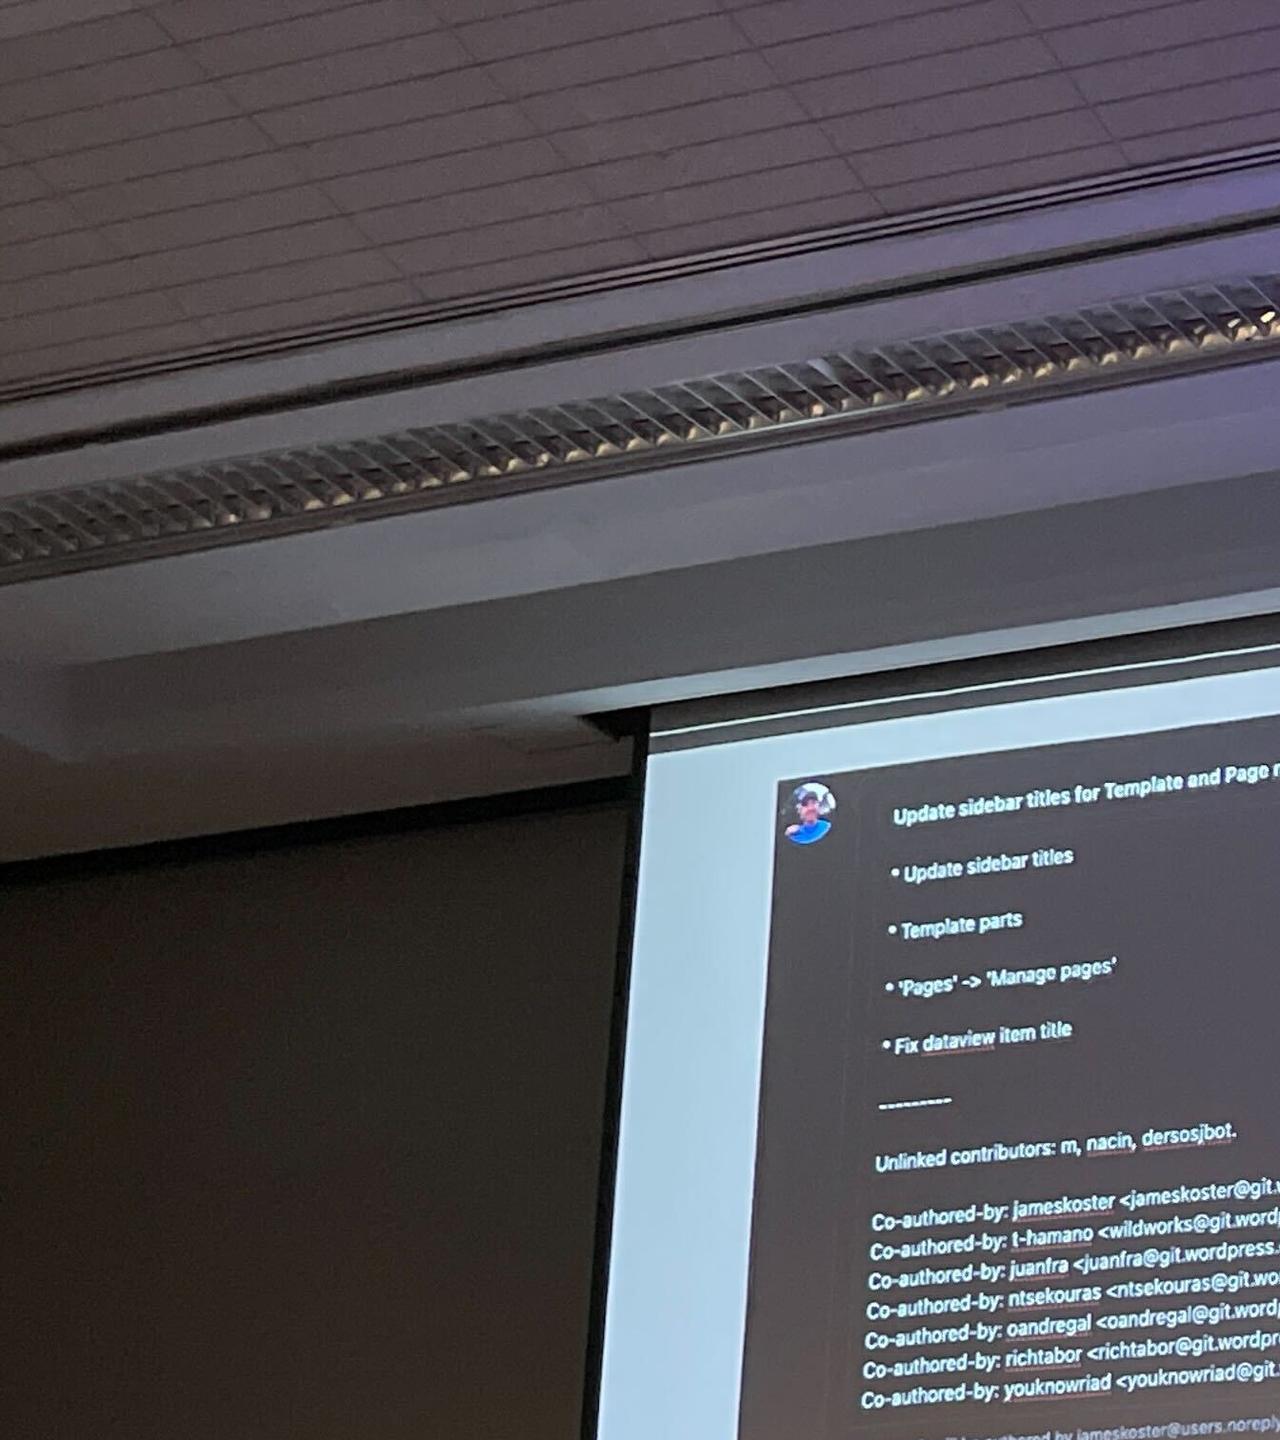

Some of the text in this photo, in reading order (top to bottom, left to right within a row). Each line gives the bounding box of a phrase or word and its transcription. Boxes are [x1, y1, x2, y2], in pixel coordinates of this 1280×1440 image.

[894, 804, 955, 827] Update
[958, 796, 1024, 817] sidebar
[1026, 789, 1071, 808] titles
[1074, 785, 1100, 803] for
[1104, 775, 1183, 799] Template
[1187, 767, 1221, 788] and
[1225, 765, 1269, 784] Page
[904, 849, 1074, 884] Update sidebar titles
[901, 913, 1022, 939] Template parts
[895, 1021, 1072, 1055] Fix dataview item title
[876, 1149, 947, 1172] Unlinked
[951, 1143, 1056, 1165] contributors:
[872, 1203, 1009, 1231] Co-authored-by:
[1012, 1195, 1116, 1222] jameskoster
[870, 1233, 1007, 1261] Co-authored-by:
[868, 1263, 1006, 1290] Co-authored-by:
[1008, 1257, 1069, 1282] juanfra
[866, 1292, 1004, 1320] Co-authored-by:
[1009, 1287, 1101, 1307] ntsekouras
[865, 1322, 1002, 1350] Co-authored-by:
[863, 1352, 1001, 1379] Co-authored-by:
[1005, 1347, 1083, 1370] richtabor
[861, 1382, 999, 1409] Co-authored-by:
[1003, 1373, 1111, 1403] youknowriad
